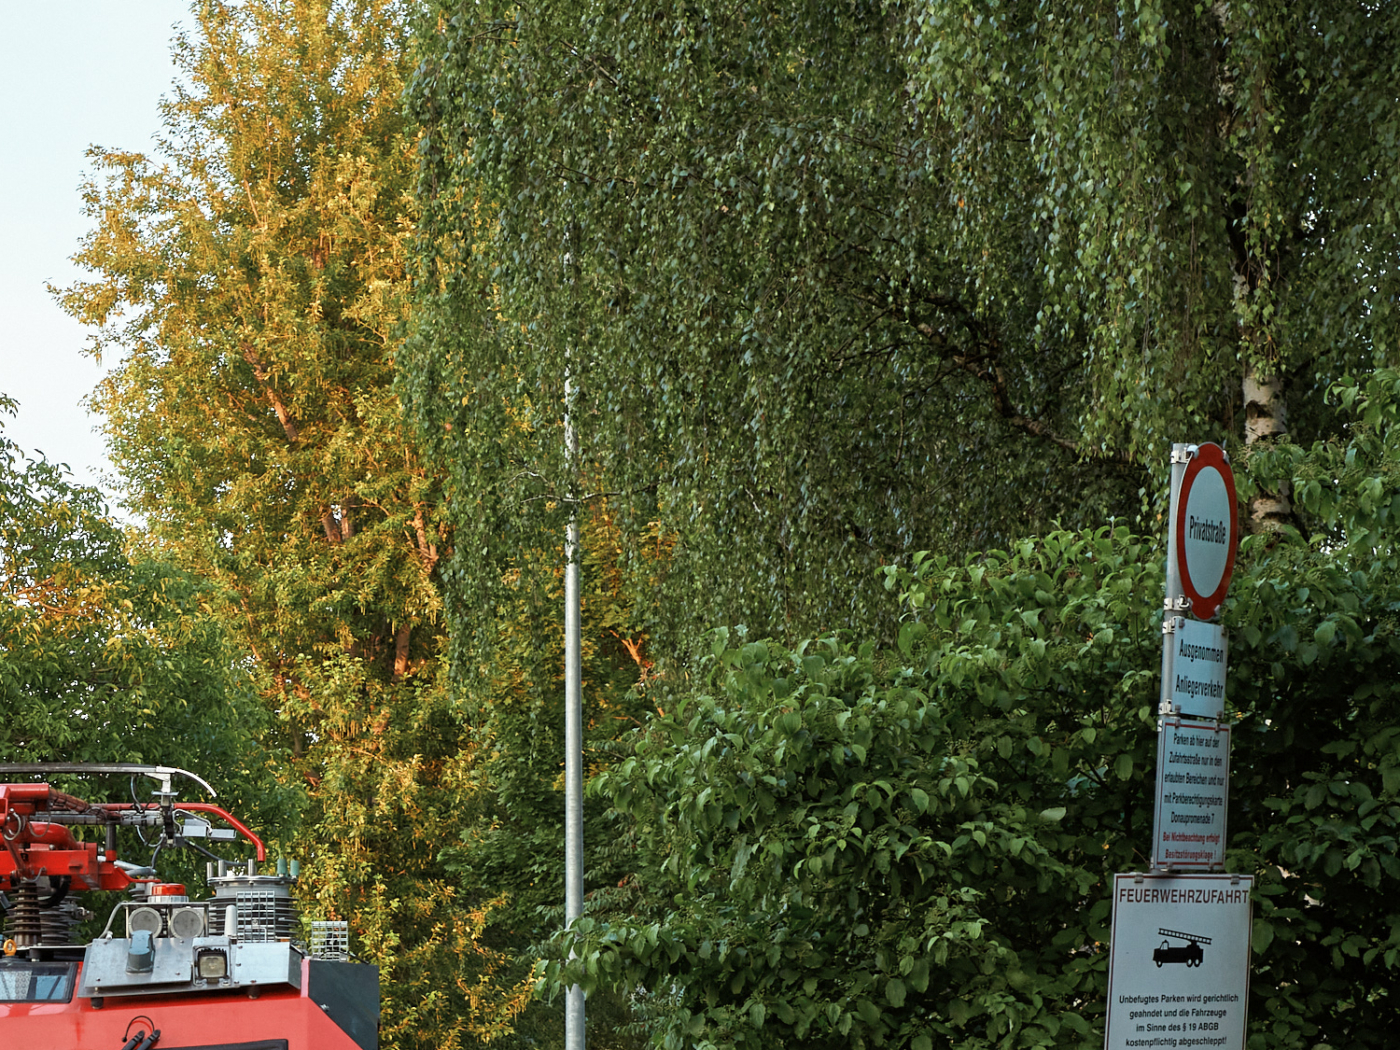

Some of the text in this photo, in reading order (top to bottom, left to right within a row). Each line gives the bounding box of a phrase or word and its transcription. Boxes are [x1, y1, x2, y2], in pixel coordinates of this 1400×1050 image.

[1189, 515, 1226, 545] Privatstraße
[1179, 638, 1224, 663] Ausgenommen
[1175, 674, 1224, 698] Anliegerverkehr
[1173, 732, 1189, 745] Parken
[1190, 734, 1196, 746] ab
[1196, 735, 1204, 746] hier
[1201, 756, 1209, 766] nur
[1209, 755, 1214, 766] in
[1214, 755, 1222, 767] den
[1164, 771, 1186, 784] erlaubten
[1186, 772, 1208, 785] Bereichen
[1208, 775, 1216, 786] und
[1170, 810, 1210, 826] Donaupromenade
[1162, 832, 1170, 842] Bei
[1171, 832, 1206, 845] Nichtbeachtung
[1119, 888, 1249, 904] FEUERWEHRZUFAHRT
[1119, 994, 1239, 1005] Unbefugtes Parken wird gerichtlich
[1130, 1008, 1227, 1020] geahndet und die Fahrzeuge
[1136, 1022, 1219, 1032] im Sinne des § 19 ABGB
[1126, 1036, 1227, 1048] kostenpflichtig abgeschleppt!
